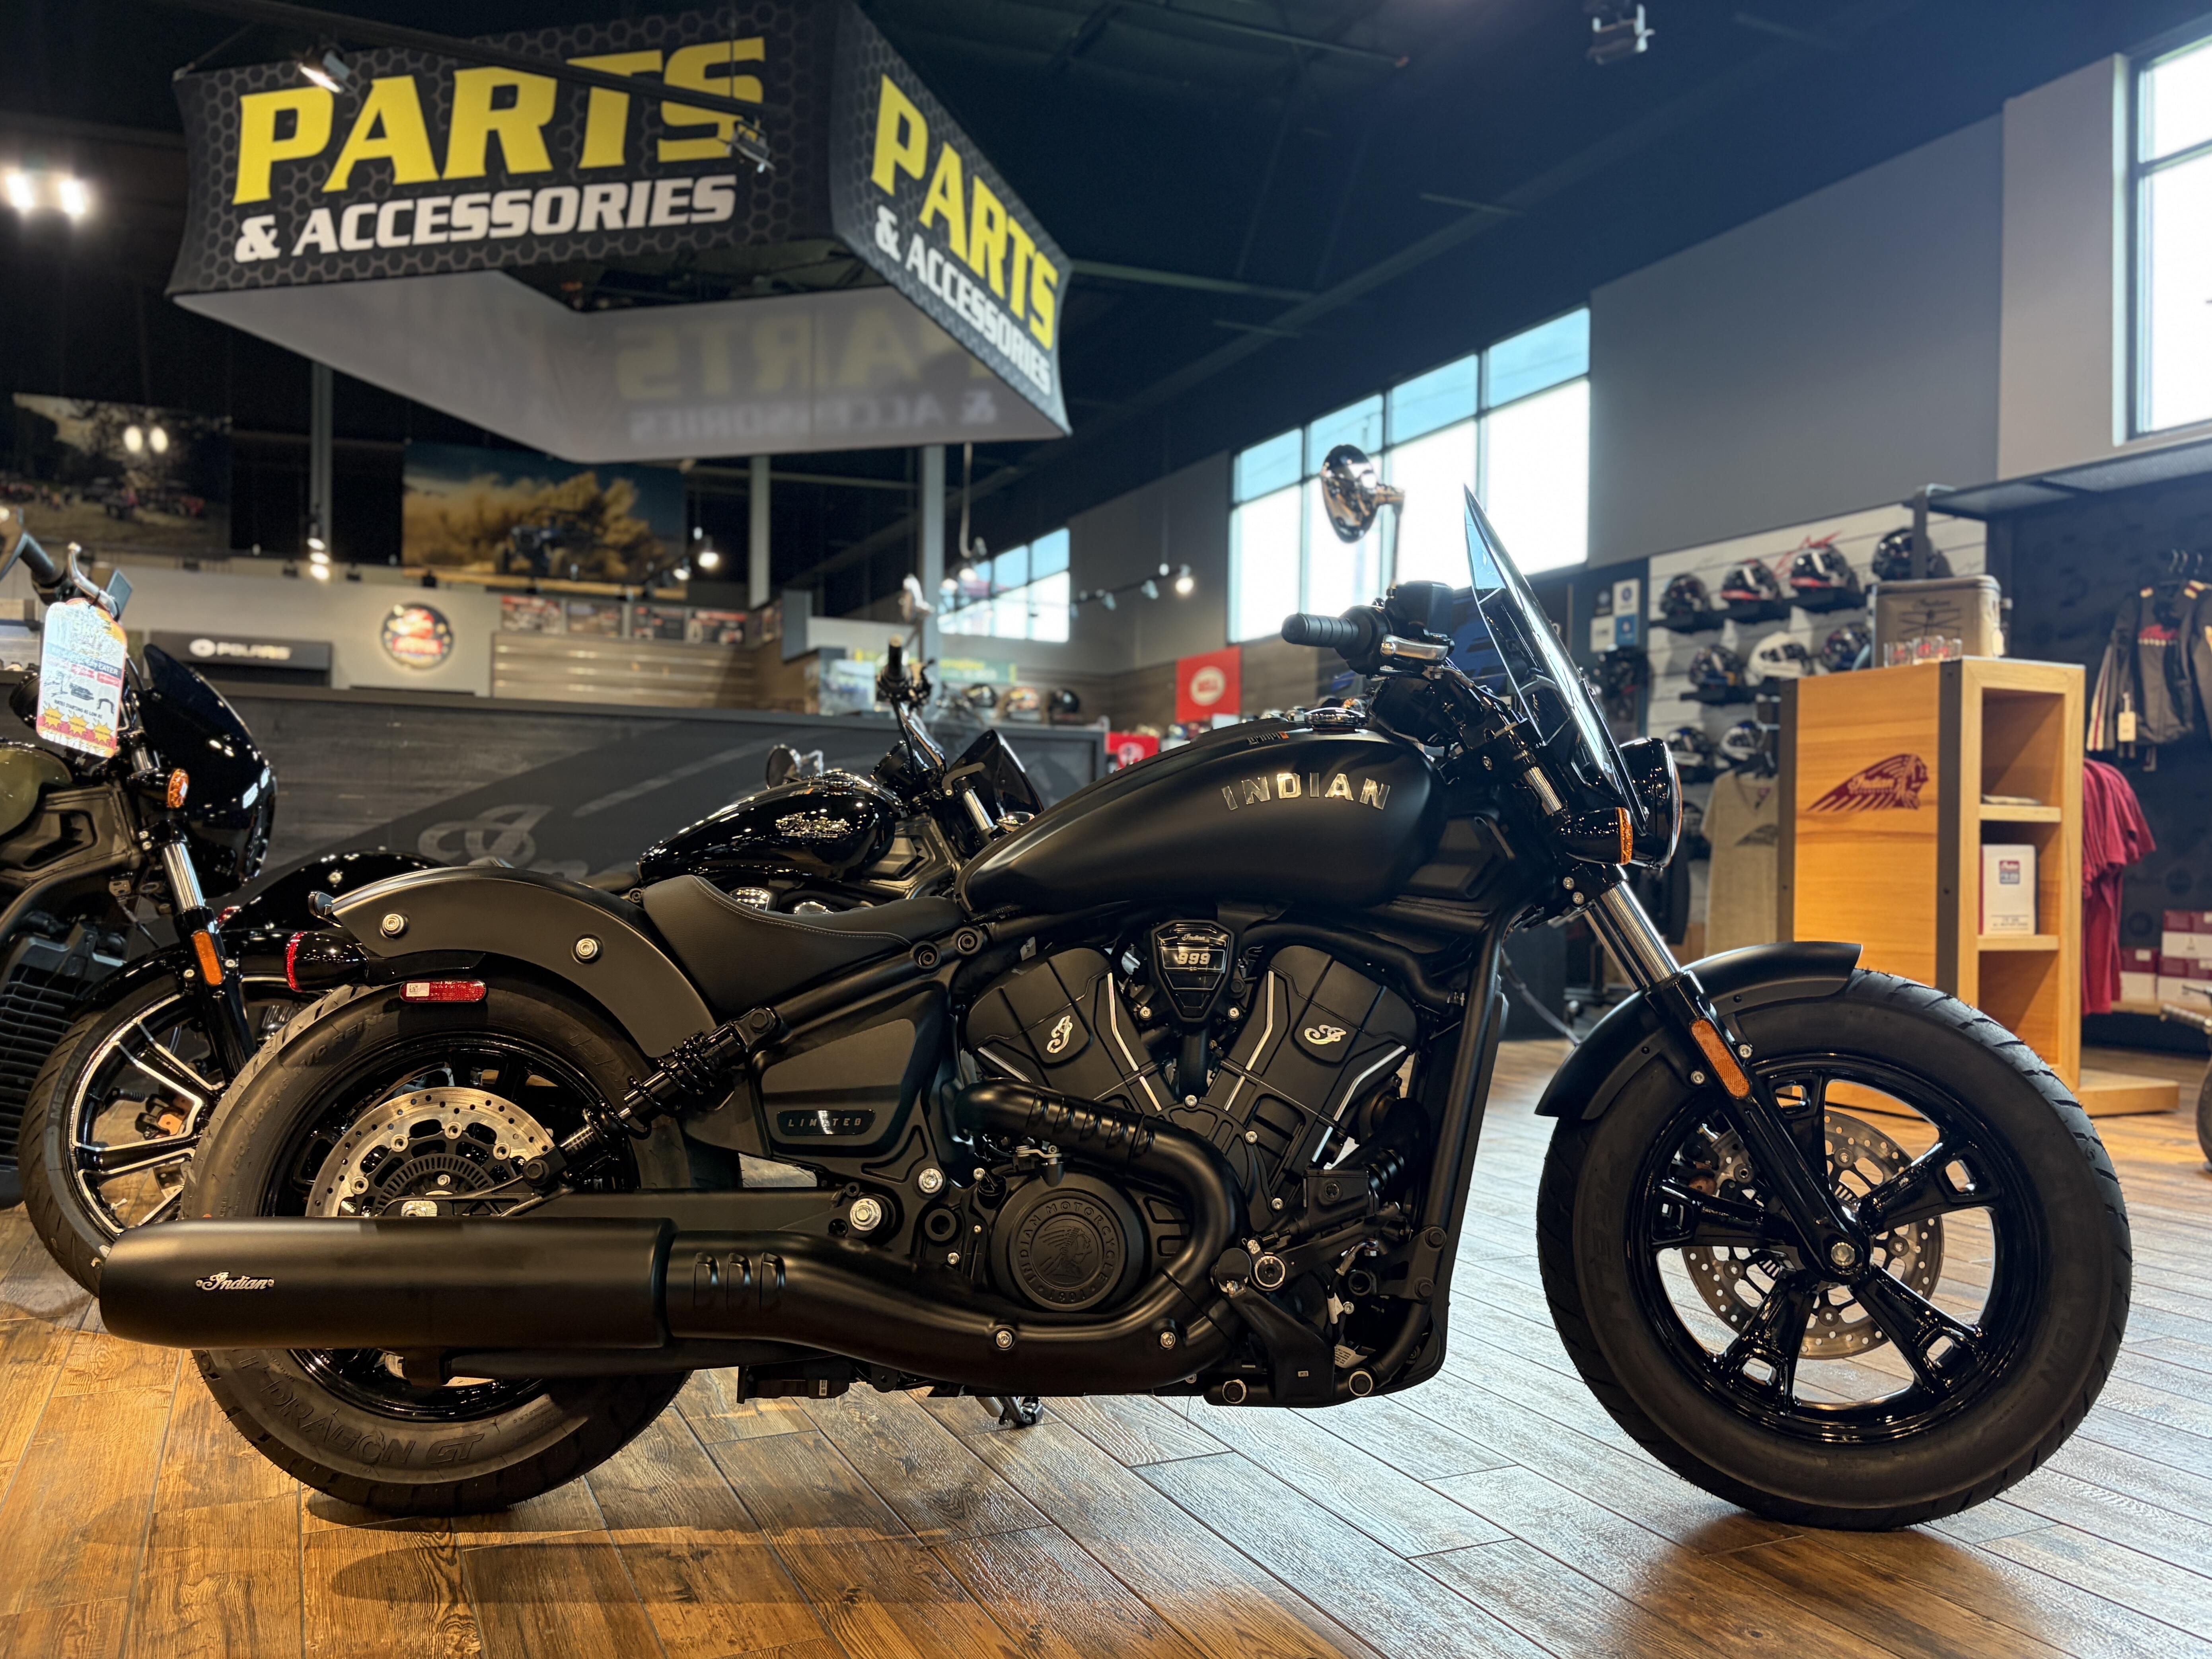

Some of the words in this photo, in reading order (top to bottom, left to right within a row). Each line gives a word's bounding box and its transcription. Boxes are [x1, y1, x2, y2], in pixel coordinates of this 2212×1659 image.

[232, 37, 765, 204] PARTS
[234, 214, 278, 263] &
[293, 174, 737, 257] ACCESSORIES
[870, 74, 1058, 352] PARTS
[874, 206, 905, 253] &
[905, 233, 1052, 397] ACCESSORIES
[1221, 772, 1390, 810] INDIAN
[1178, 952, 1211, 965] 999
[788, 1118, 862, 1127] LIMTED
[201, 1271, 268, 1291] Indian
[1020, 1214, 1042, 1283] INDIAN
[1046, 1201, 1115, 1283] MOTORCYCLE
[1049, 1289, 1086, 1302] 1901
[260, 1379, 417, 1465] DRAGON
[426, 1433, 485, 1464] GT
